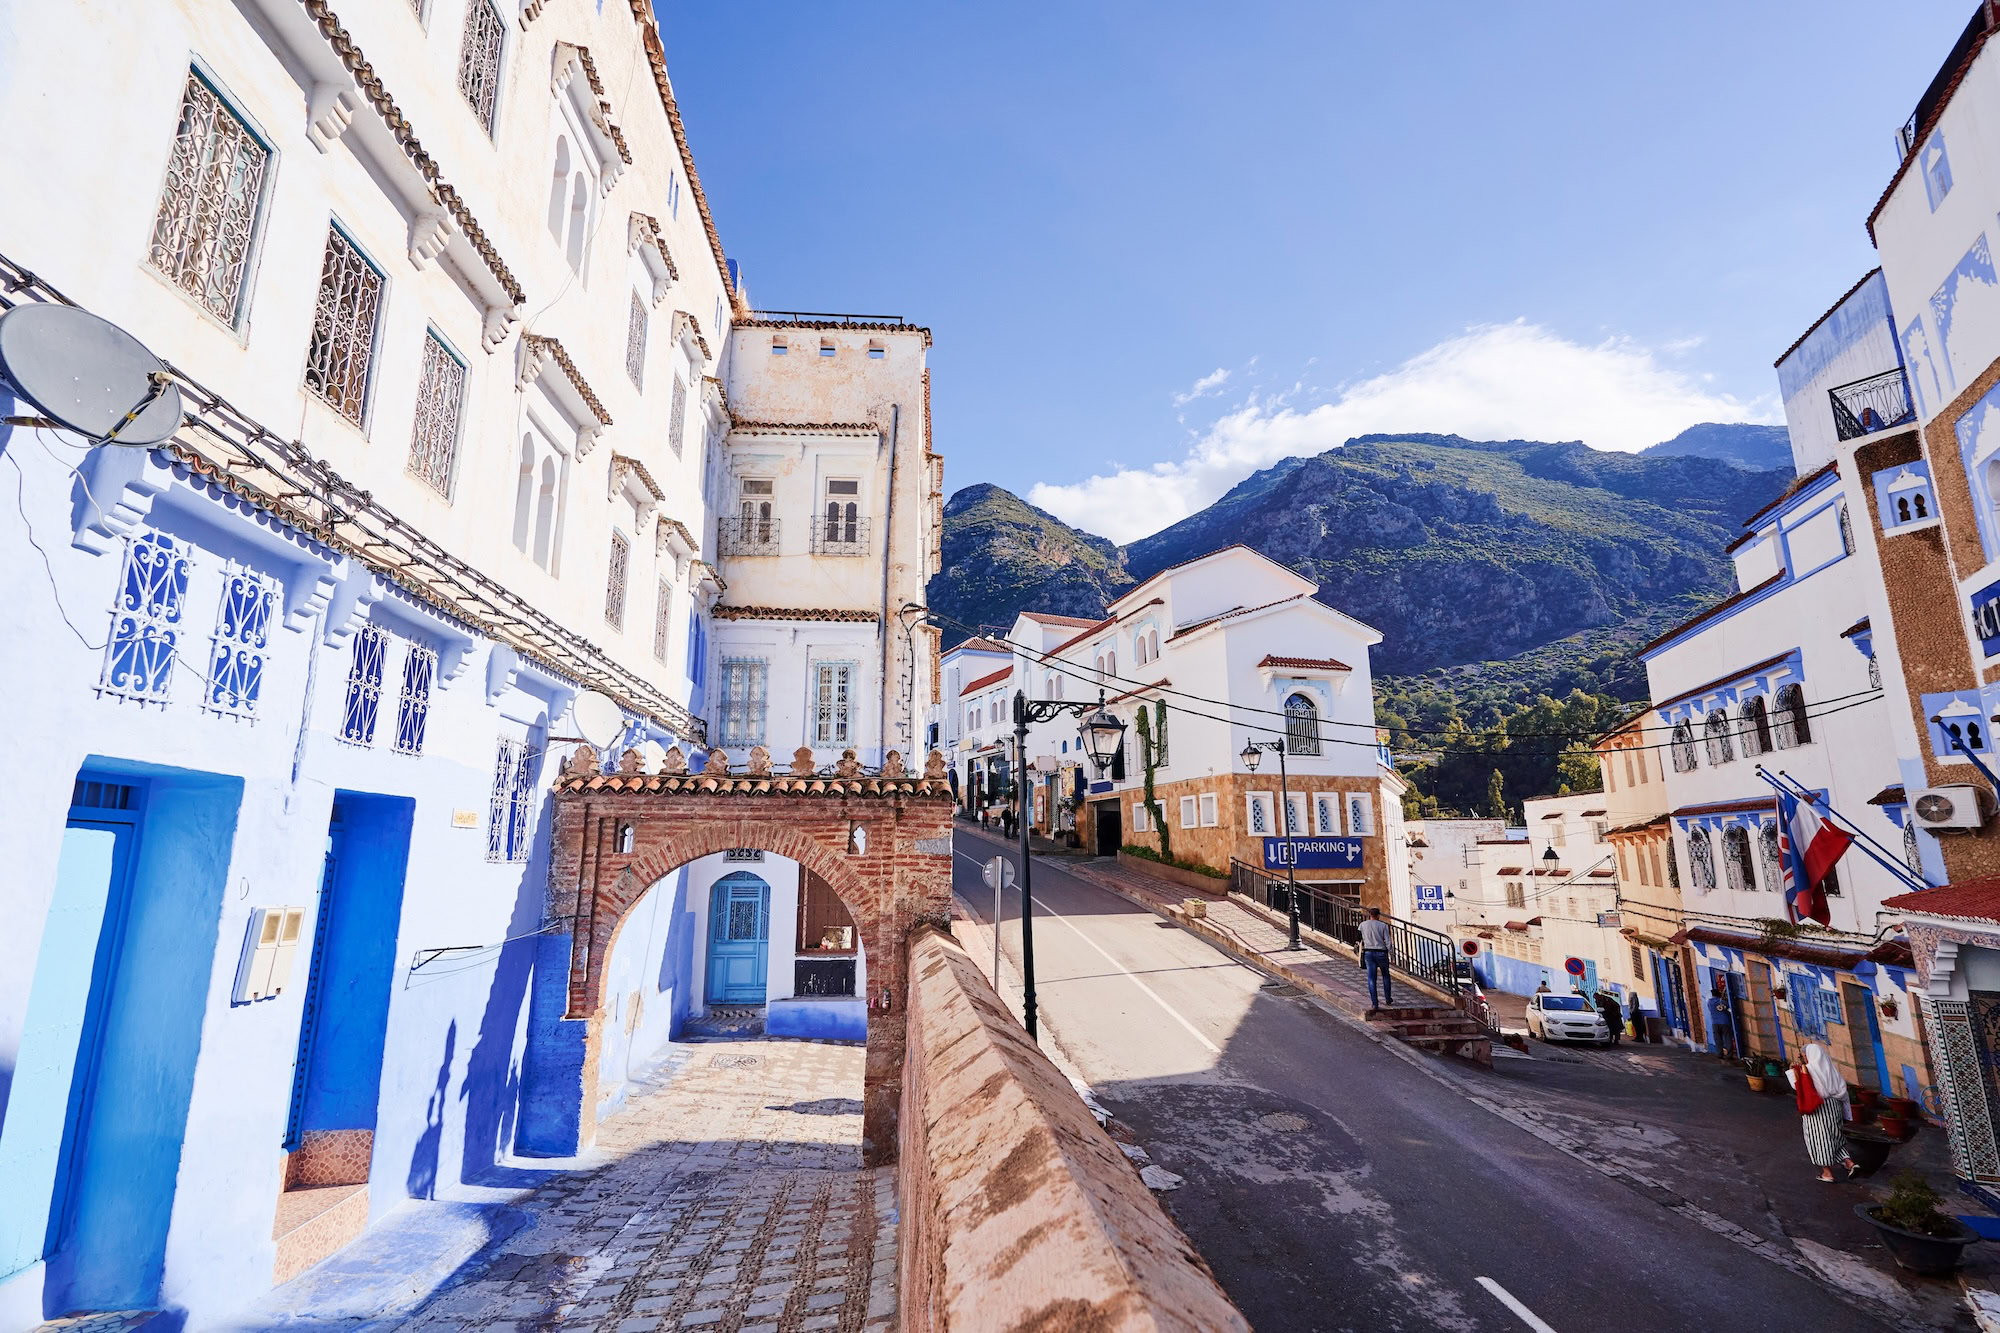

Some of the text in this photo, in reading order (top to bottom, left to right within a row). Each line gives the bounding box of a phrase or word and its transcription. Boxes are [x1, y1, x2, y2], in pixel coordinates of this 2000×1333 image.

[1972, 596, 2000, 641] HOT
[1297, 842, 1346, 852] PARKING
[1426, 888, 1433, 897] P
